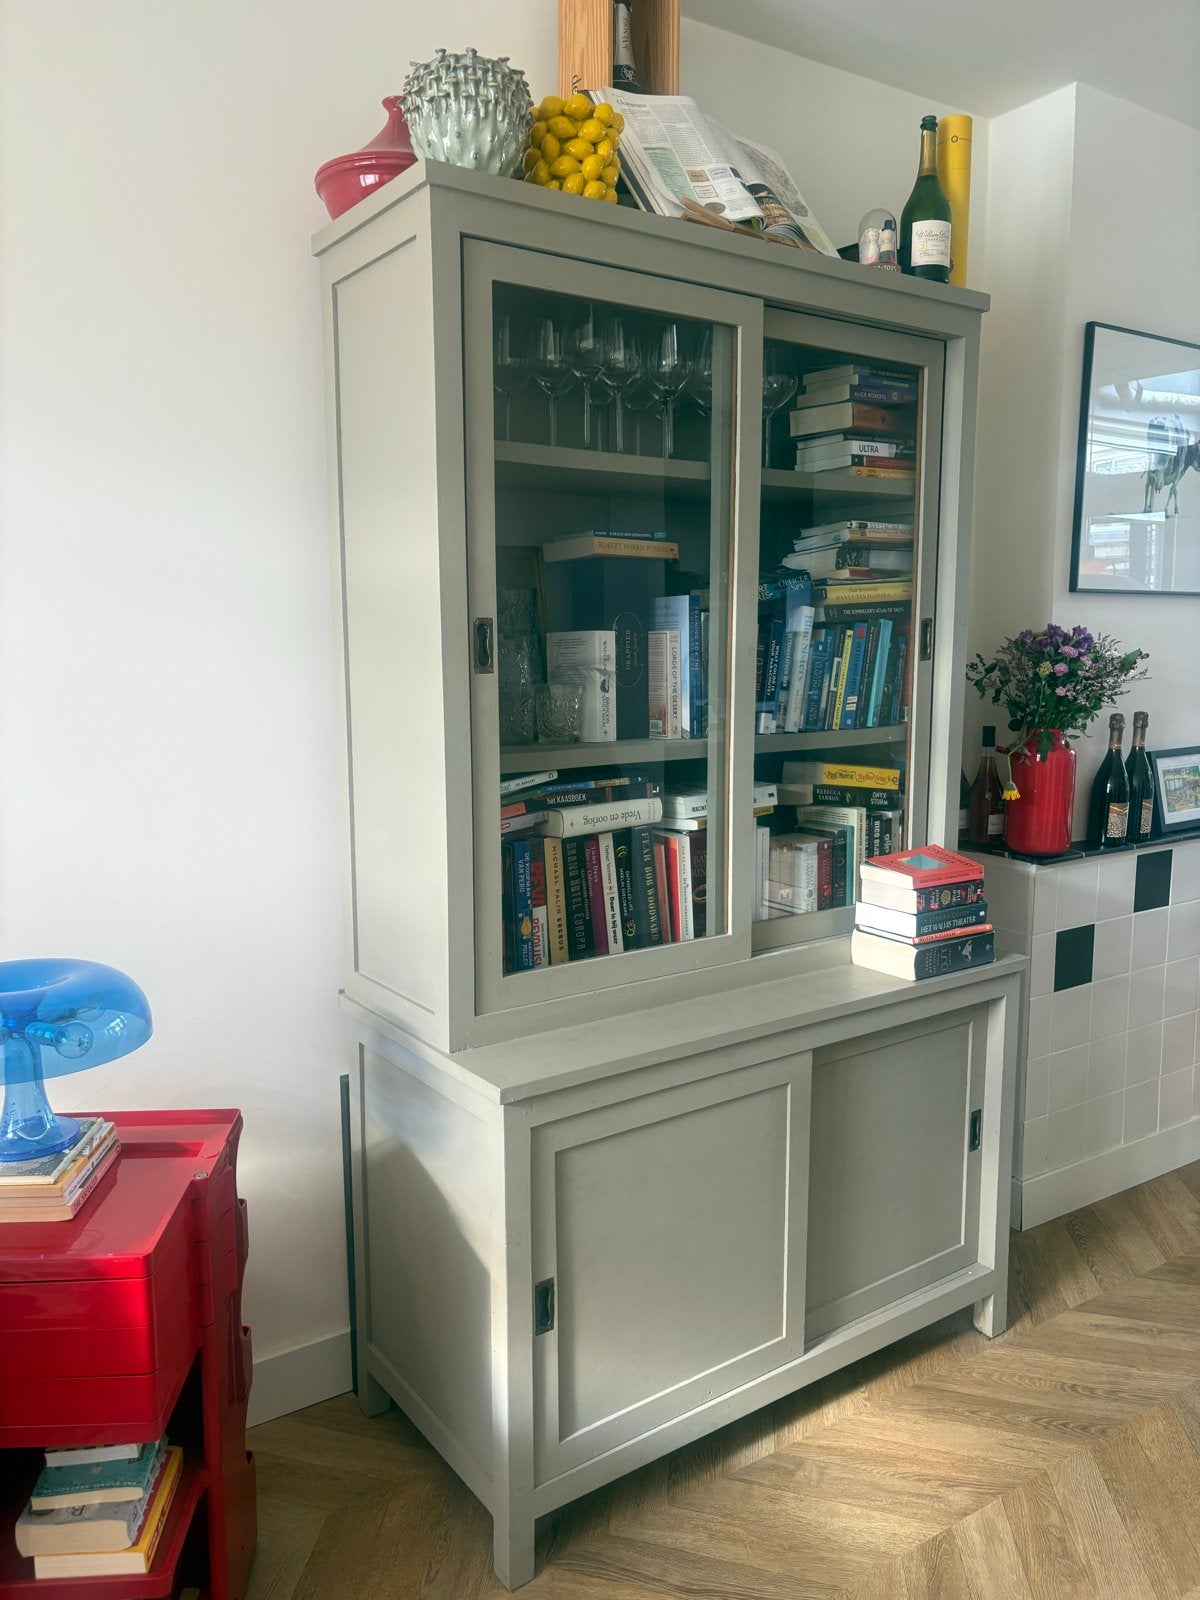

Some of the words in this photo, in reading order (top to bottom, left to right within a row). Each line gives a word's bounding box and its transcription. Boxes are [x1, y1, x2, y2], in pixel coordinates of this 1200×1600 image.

[858, 444, 879, 454] ULTRA
[783, 633, 793, 675] ULTRAMARATHON
[797, 643, 809, 682] Sisters
[842, 640, 850, 668] MIDNIGHT
[672, 671, 677, 681] OF
[766, 657, 774, 696] PARACHUTE?
[838, 669, 846, 691] LIBRARY
[838, 771, 854, 780] Murray
[556, 793, 587, 803] KAASBOEK
[583, 815, 608, 827] oorlog
[620, 810, 641, 822] Vrede
[524, 852, 530, 862] DE
[641, 833, 650, 862] FEAR
[567, 842, 579, 877] GRAND
[644, 866, 653, 885] BOB
[570, 879, 582, 910] HOTEL
[647, 887, 659, 940] WOODWARD
[573, 914, 585, 950] EUROPA
[920, 925, 933, 933] HET
[72, 1197, 81, 1212] THE
